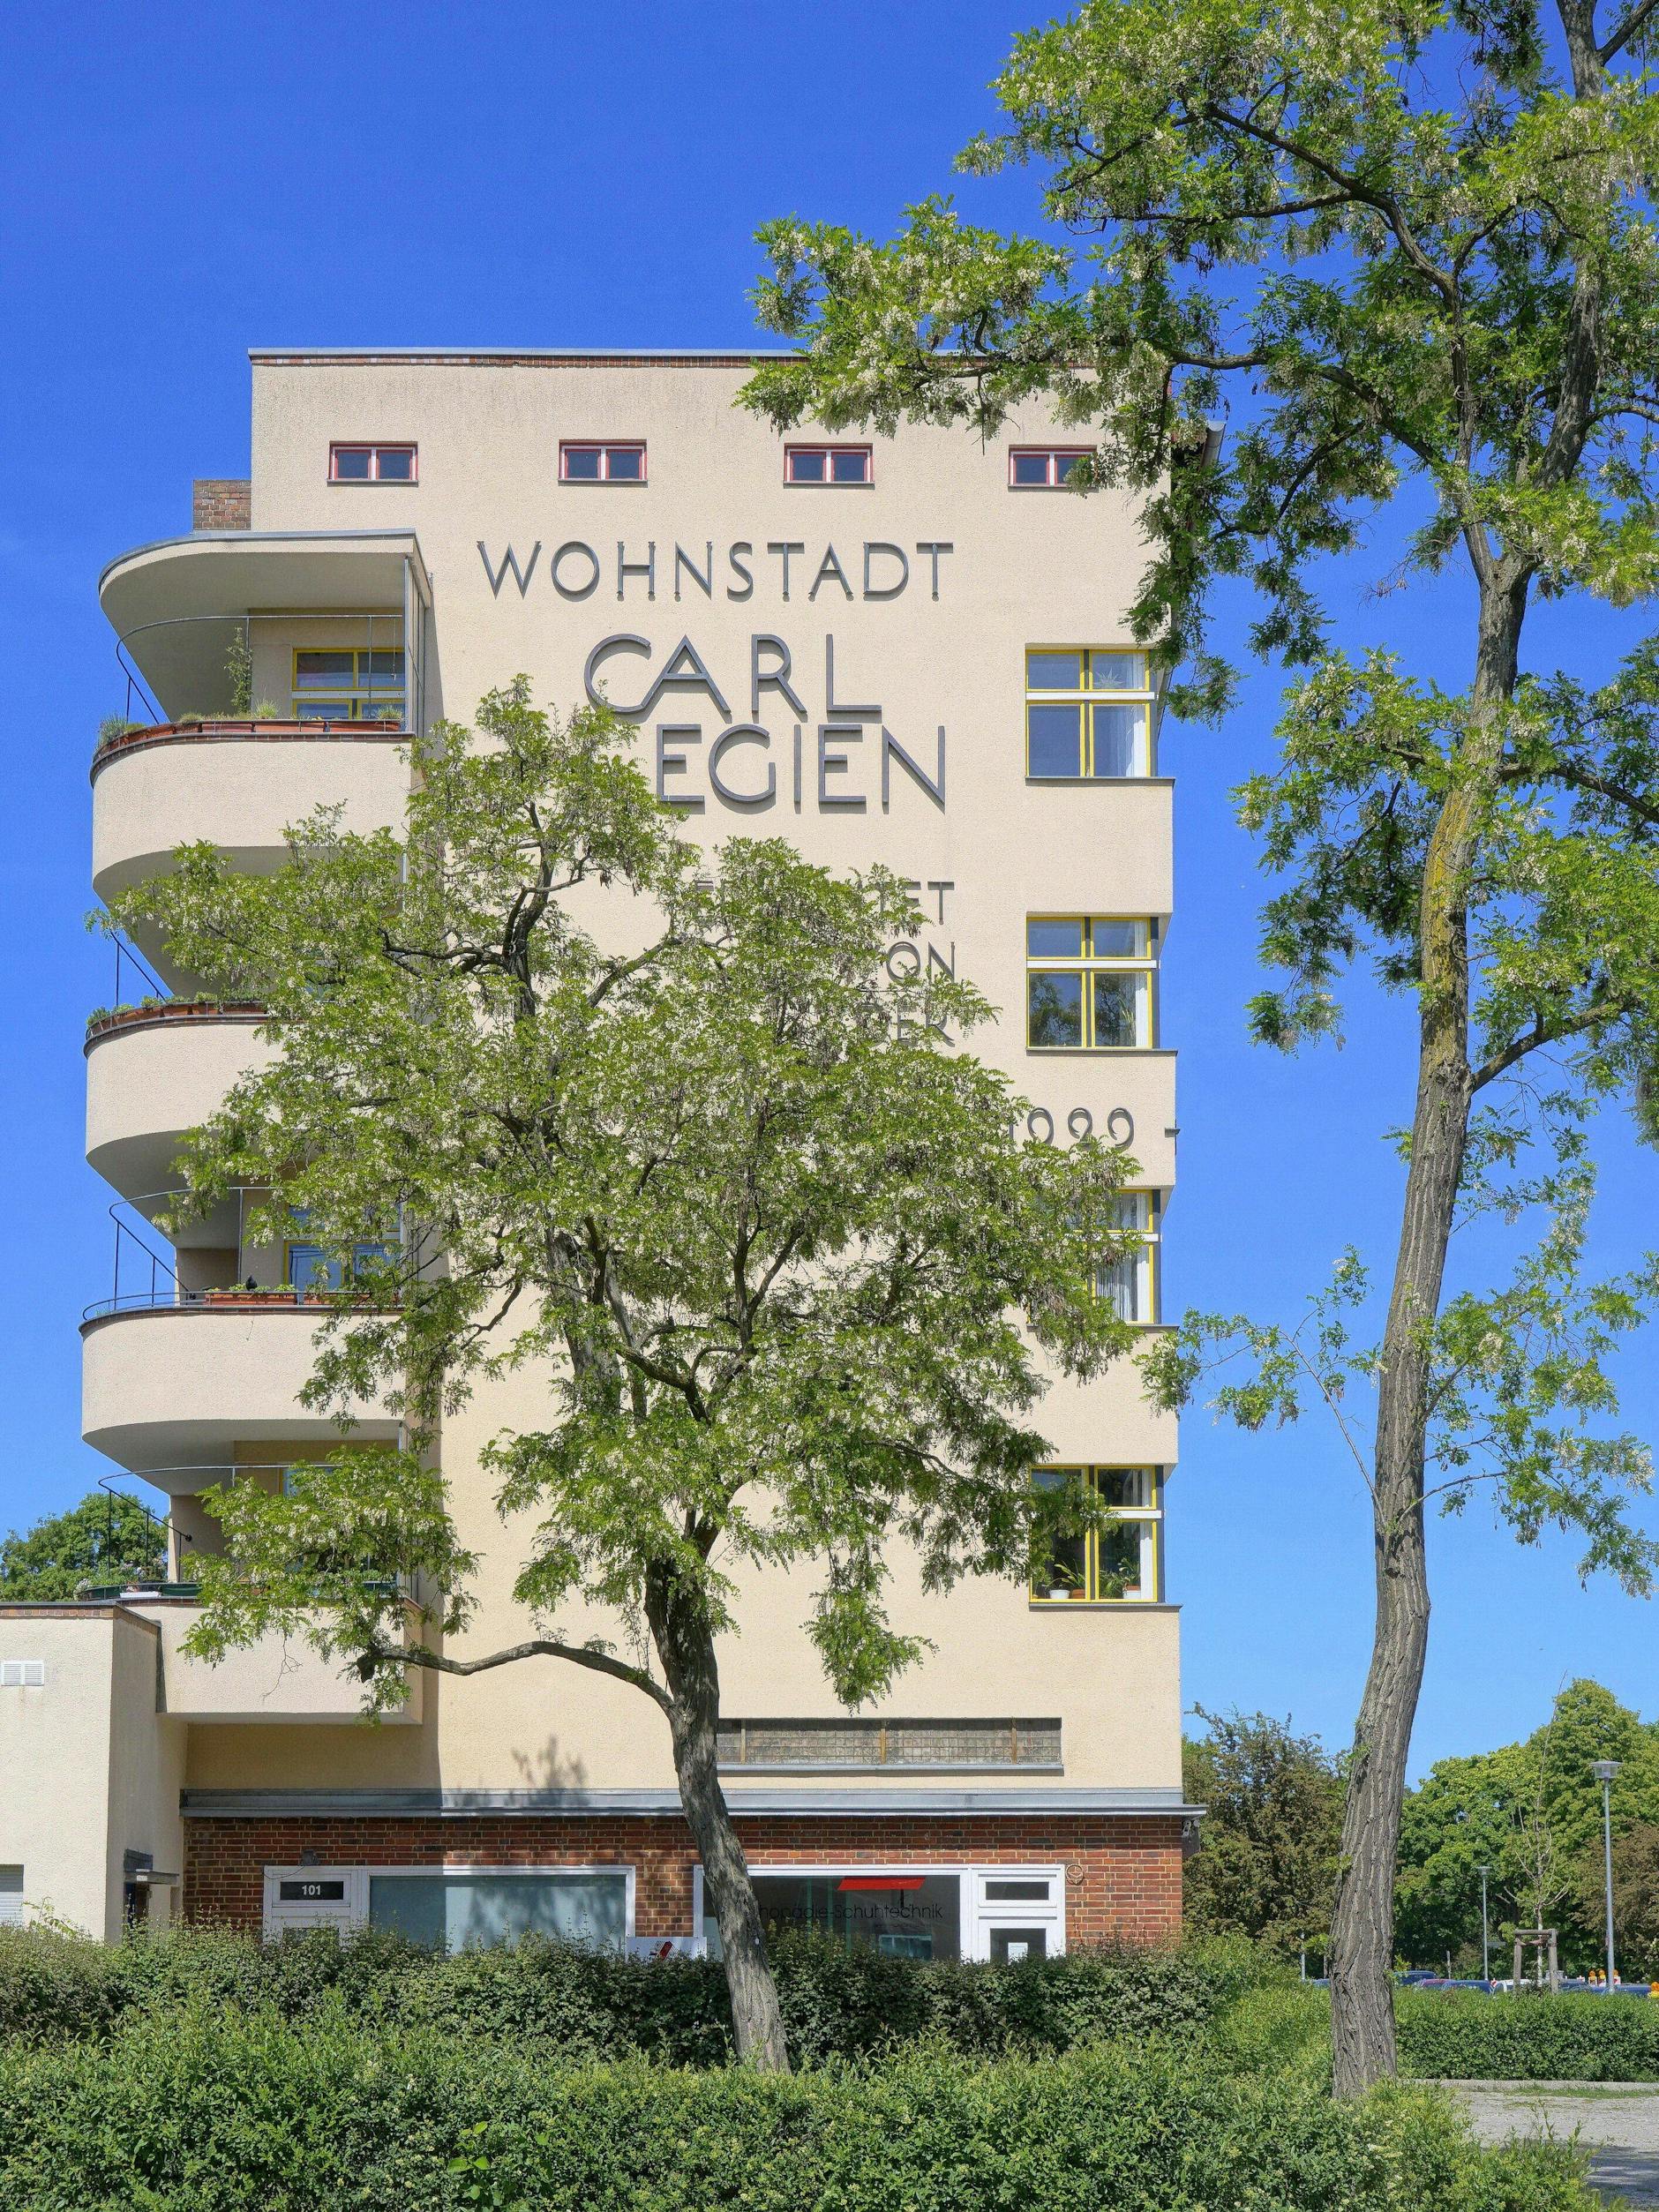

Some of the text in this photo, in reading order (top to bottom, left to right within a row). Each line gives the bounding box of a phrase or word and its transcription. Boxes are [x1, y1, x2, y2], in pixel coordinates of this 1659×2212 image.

[477, 540, 954, 600] WOHNSTADT
[583, 633, 882, 716] CARL
[656, 724, 946, 806] EGIEN
[885, 941, 956, 986] ON
[302, 1884, 321, 1896] 101
[759, 1902, 943, 1923] hopädie-Schuhtechnik
